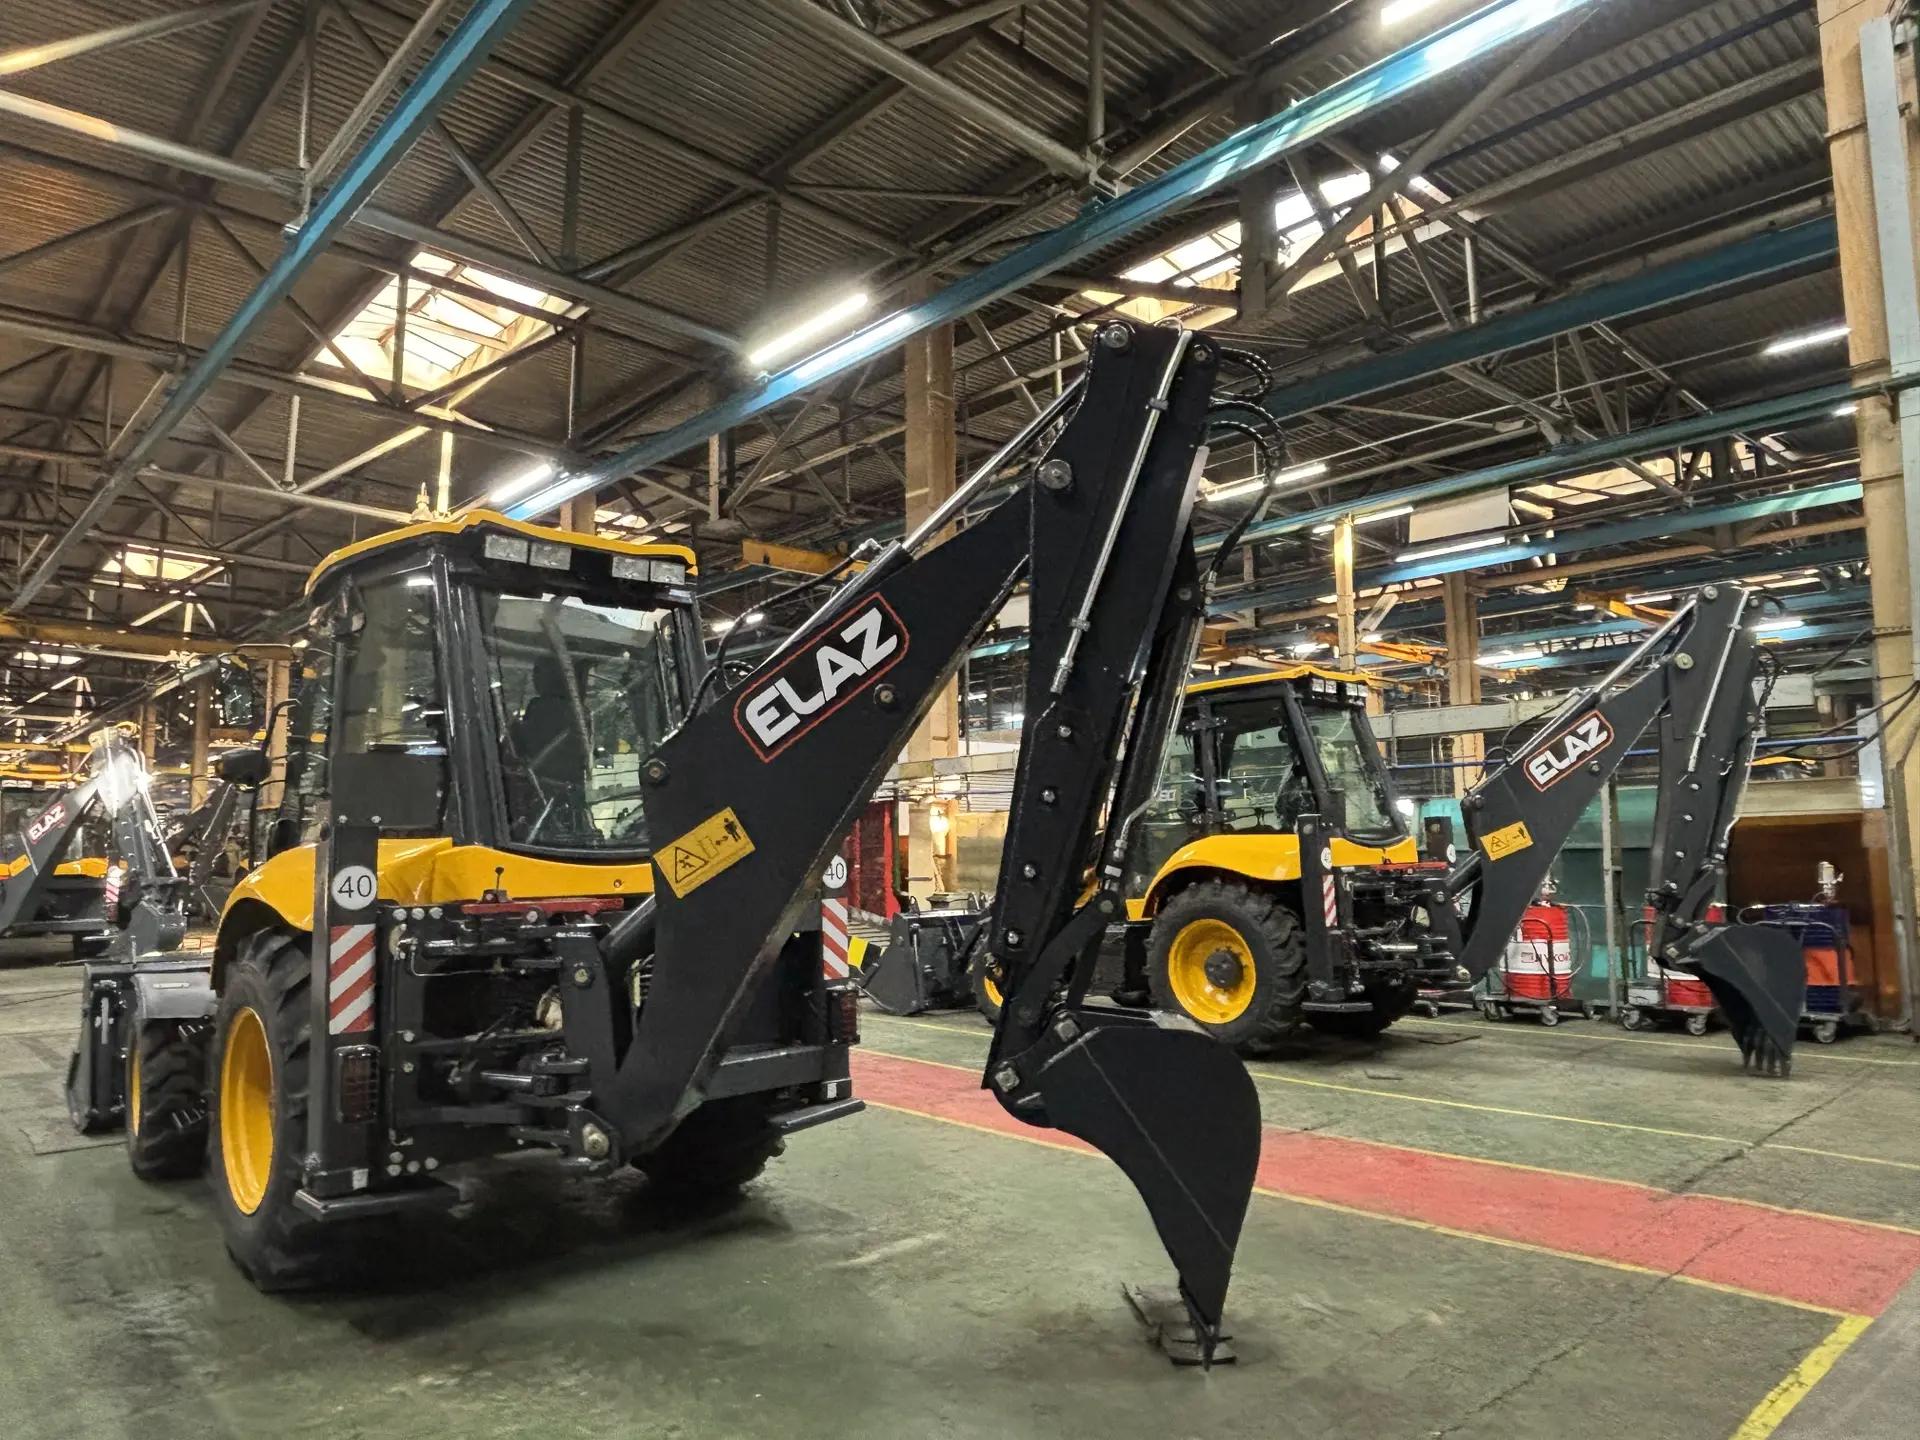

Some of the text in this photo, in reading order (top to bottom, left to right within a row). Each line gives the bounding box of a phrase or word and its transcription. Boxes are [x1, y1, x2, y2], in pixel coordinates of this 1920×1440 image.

[745, 607, 898, 747] ELAZ
[1528, 717, 1608, 785] ELAZ
[29, 805, 65, 840] ELAZ
[337, 875, 372, 898] 40
[824, 863, 844, 880] 40
